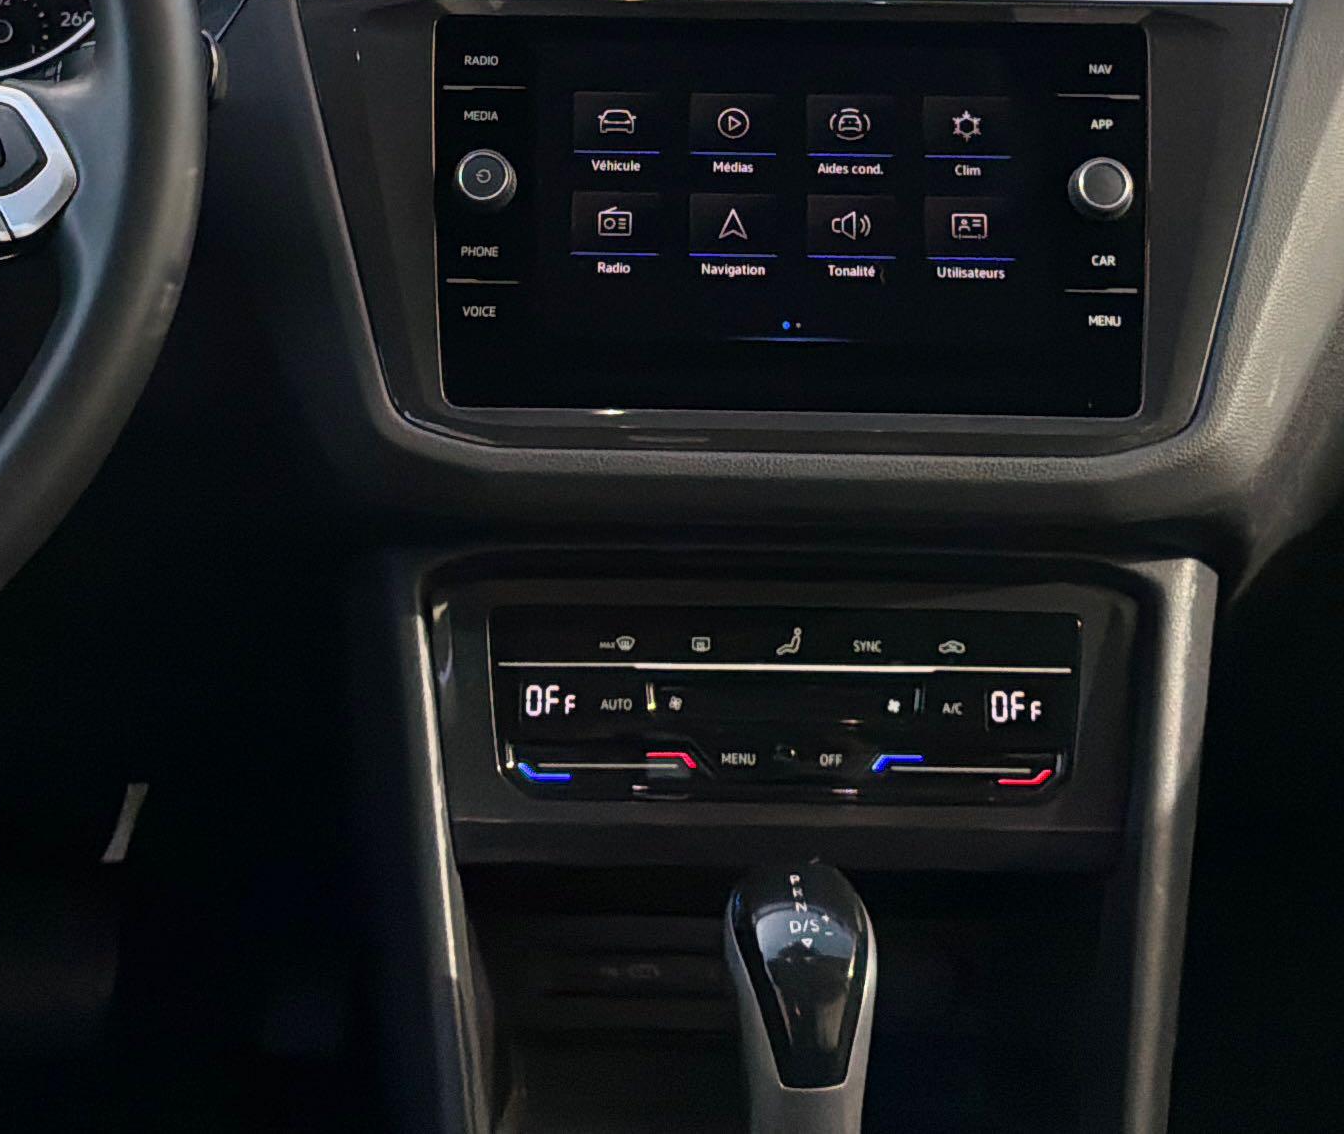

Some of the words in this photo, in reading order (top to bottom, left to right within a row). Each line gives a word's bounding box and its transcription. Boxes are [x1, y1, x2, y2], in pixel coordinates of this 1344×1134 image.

[464, 55, 499, 66] RADIO
[1088, 63, 1113, 76] NAV
[463, 110, 499, 122] MEDIA
[1090, 119, 1114, 131] APP
[591, 158, 641, 173] Véhicule
[712, 160, 754, 174] Médias
[817, 163, 850, 176] Aides
[852, 163, 885, 176] cond.
[954, 165, 981, 177] Clim
[460, 245, 499, 258] PHONE
[1091, 254, 1116, 267] CAR
[597, 261, 631, 274] Radio
[701, 262, 766, 278] Navigation
[828, 265, 876, 279] Tonalité
[936, 266, 1006, 280] Utilisateurs
[462, 305, 497, 318] VOICE
[1088, 315, 1122, 328] MENU
[599, 640, 616, 649] MAX
[852, 639, 882, 654] SYNC
[600, 697, 633, 712] AUTO
[942, 702, 964, 716] A/C
[720, 752, 757, 766] MENU
[819, 753, 843, 767] OFF
[795, 900, 808, 912] N
[789, 919, 820, 934] D/S
